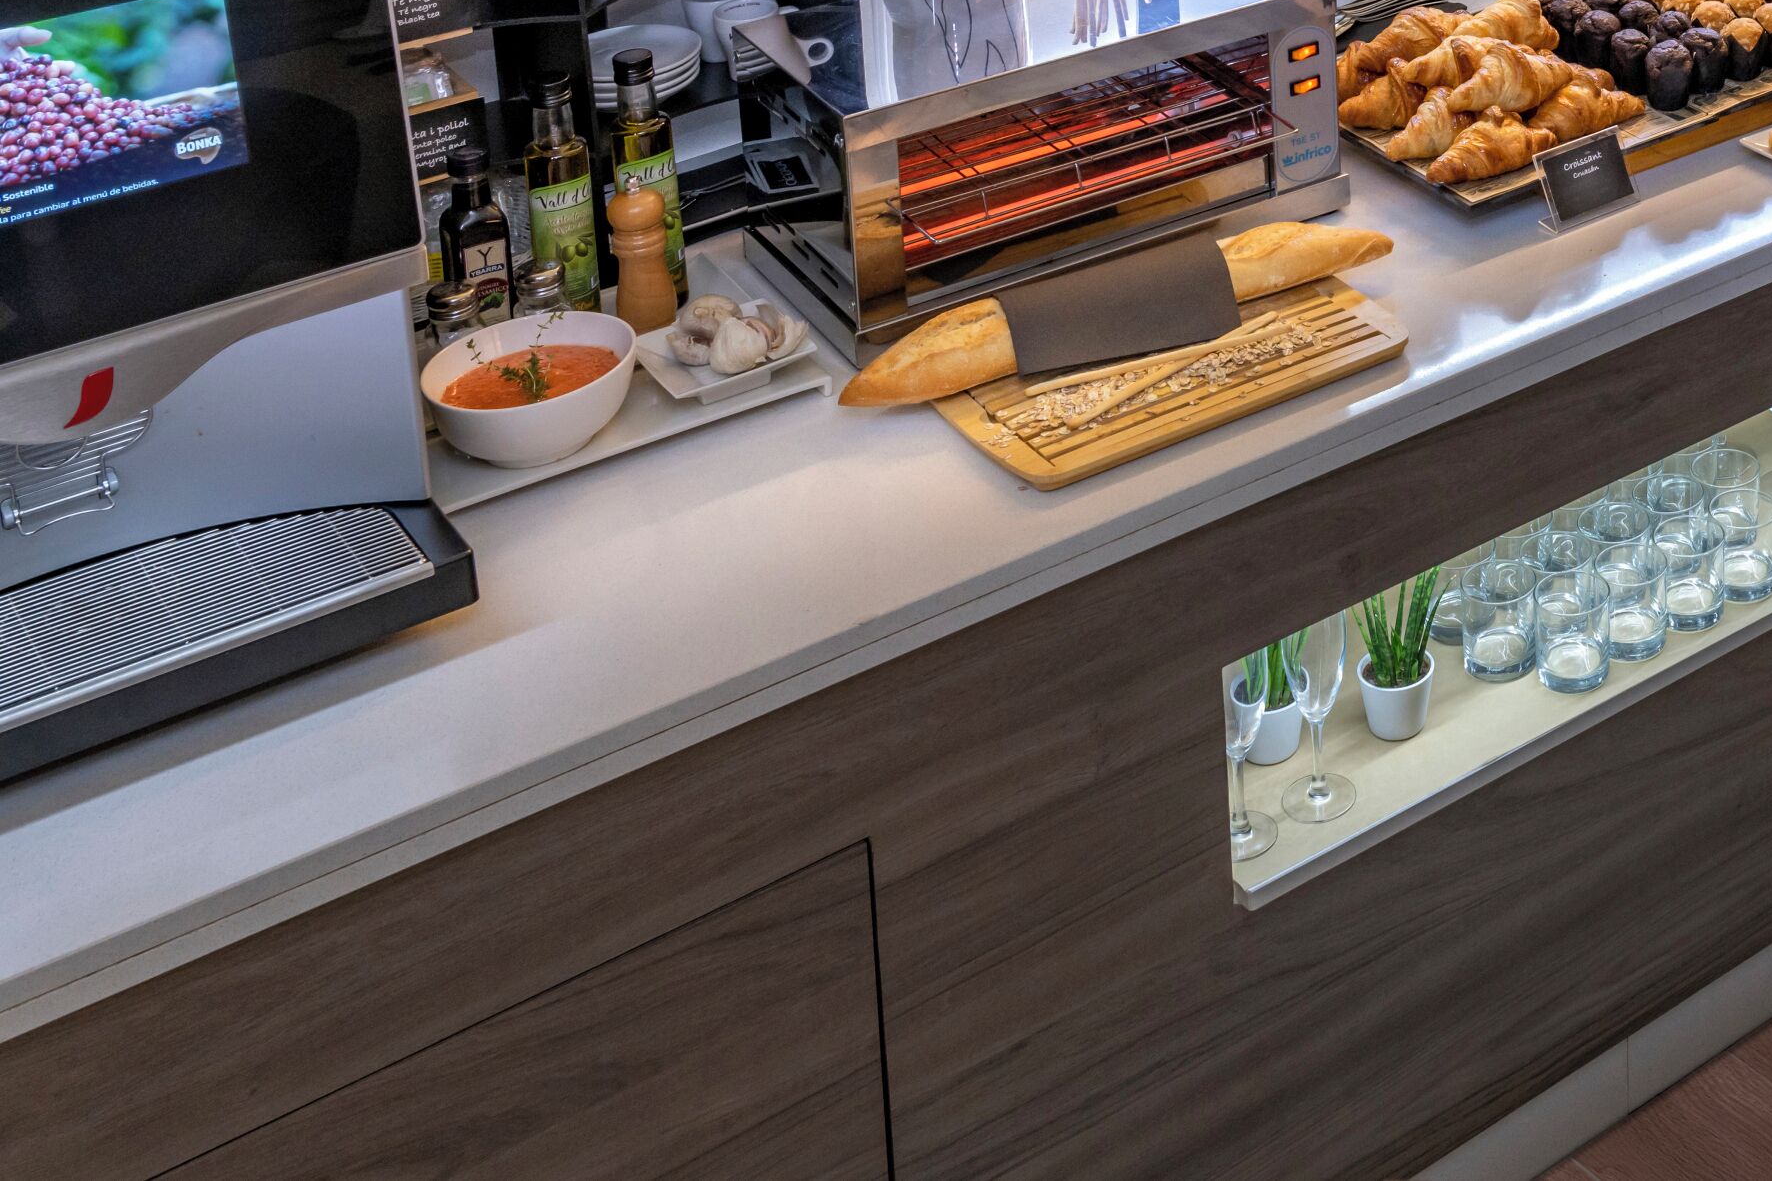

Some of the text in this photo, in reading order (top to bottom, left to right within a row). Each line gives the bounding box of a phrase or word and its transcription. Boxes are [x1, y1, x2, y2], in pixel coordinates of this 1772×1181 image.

[411, 2, 438, 13] negro
[397, 11, 441, 27] Black tea
[429, 126, 435, 136] i
[436, 117, 470, 137] poliol
[175, 134, 223, 156] BONKA
[448, 139, 467, 151] and
[1295, 145, 1333, 162] infrico
[1563, 150, 1603, 171] Croissant
[2, 182, 55, 203] Sostenible
[10, 211, 32, 223] para
[33, 201, 71, 216] cambiar
[72, 197, 82, 208] al
[82, 190, 109, 204] menú
[109, 187, 121, 197] de
[121, 177, 160, 194] bebidas.
[535, 189, 568, 210] Vall
[470, 264, 504, 278] YBARRA
